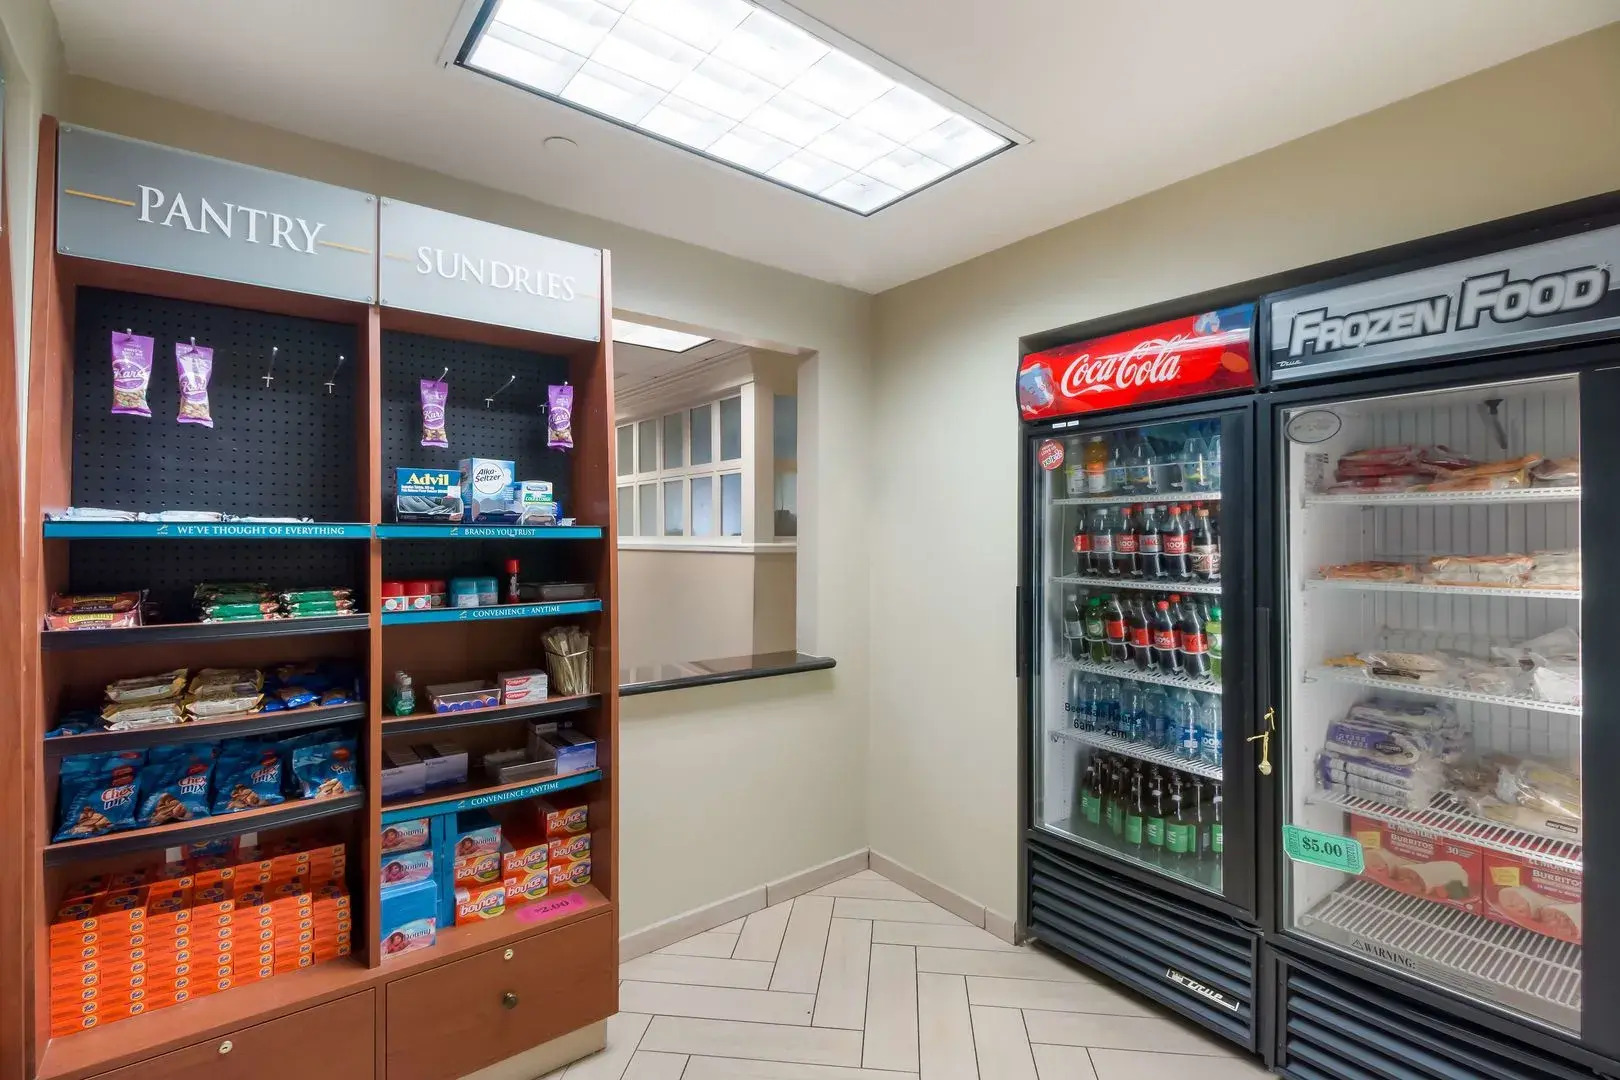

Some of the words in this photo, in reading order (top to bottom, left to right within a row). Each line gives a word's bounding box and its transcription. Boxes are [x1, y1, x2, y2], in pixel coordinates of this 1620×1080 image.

[137, 184, 326, 255] PANTRY
[416, 246, 576, 301] SUNDRIES
[1288, 294, 1453, 358] FROZEN
[1455, 266, 1611, 331] FOOD
[406, 472, 449, 486] Advil
[475, 474, 501, 484] Seltzer
[477, 468, 497, 476] Alka-
[178, 526, 209, 535] WE'VE
[213, 526, 268, 535] THOUGHT
[270, 527, 282, 535] OF
[285, 526, 345, 536] EVERYTHING
[472, 608, 526, 618] CONVENIENCE
[531, 606, 561, 614] ANYTIME
[1074, 718, 1094, 732] 6am
[1104, 724, 1127, 738] 2am
[178, 776, 206, 786] Chex
[181, 784, 206, 794] mix
[102, 786, 135, 802] Chex
[104, 796, 131, 810] mix
[472, 790, 524, 806] CONVENIENCE
[530, 782, 560, 794] ANYTIME
[551, 812, 580, 830] bounce
[553, 840, 584, 858] bounce
[1302, 836, 1342, 858] $5.00
[1391, 834, 1434, 850] BURRITOS
[458, 860, 494, 878] bounce
[508, 852, 540, 870] bounce
[553, 866, 584, 884] bounce
[1533, 869, 1582, 886] BURRITO
[508, 877, 541, 896] bounce
[461, 896, 498, 916] bounce
[1364, 942, 1416, 970] WARNING:
